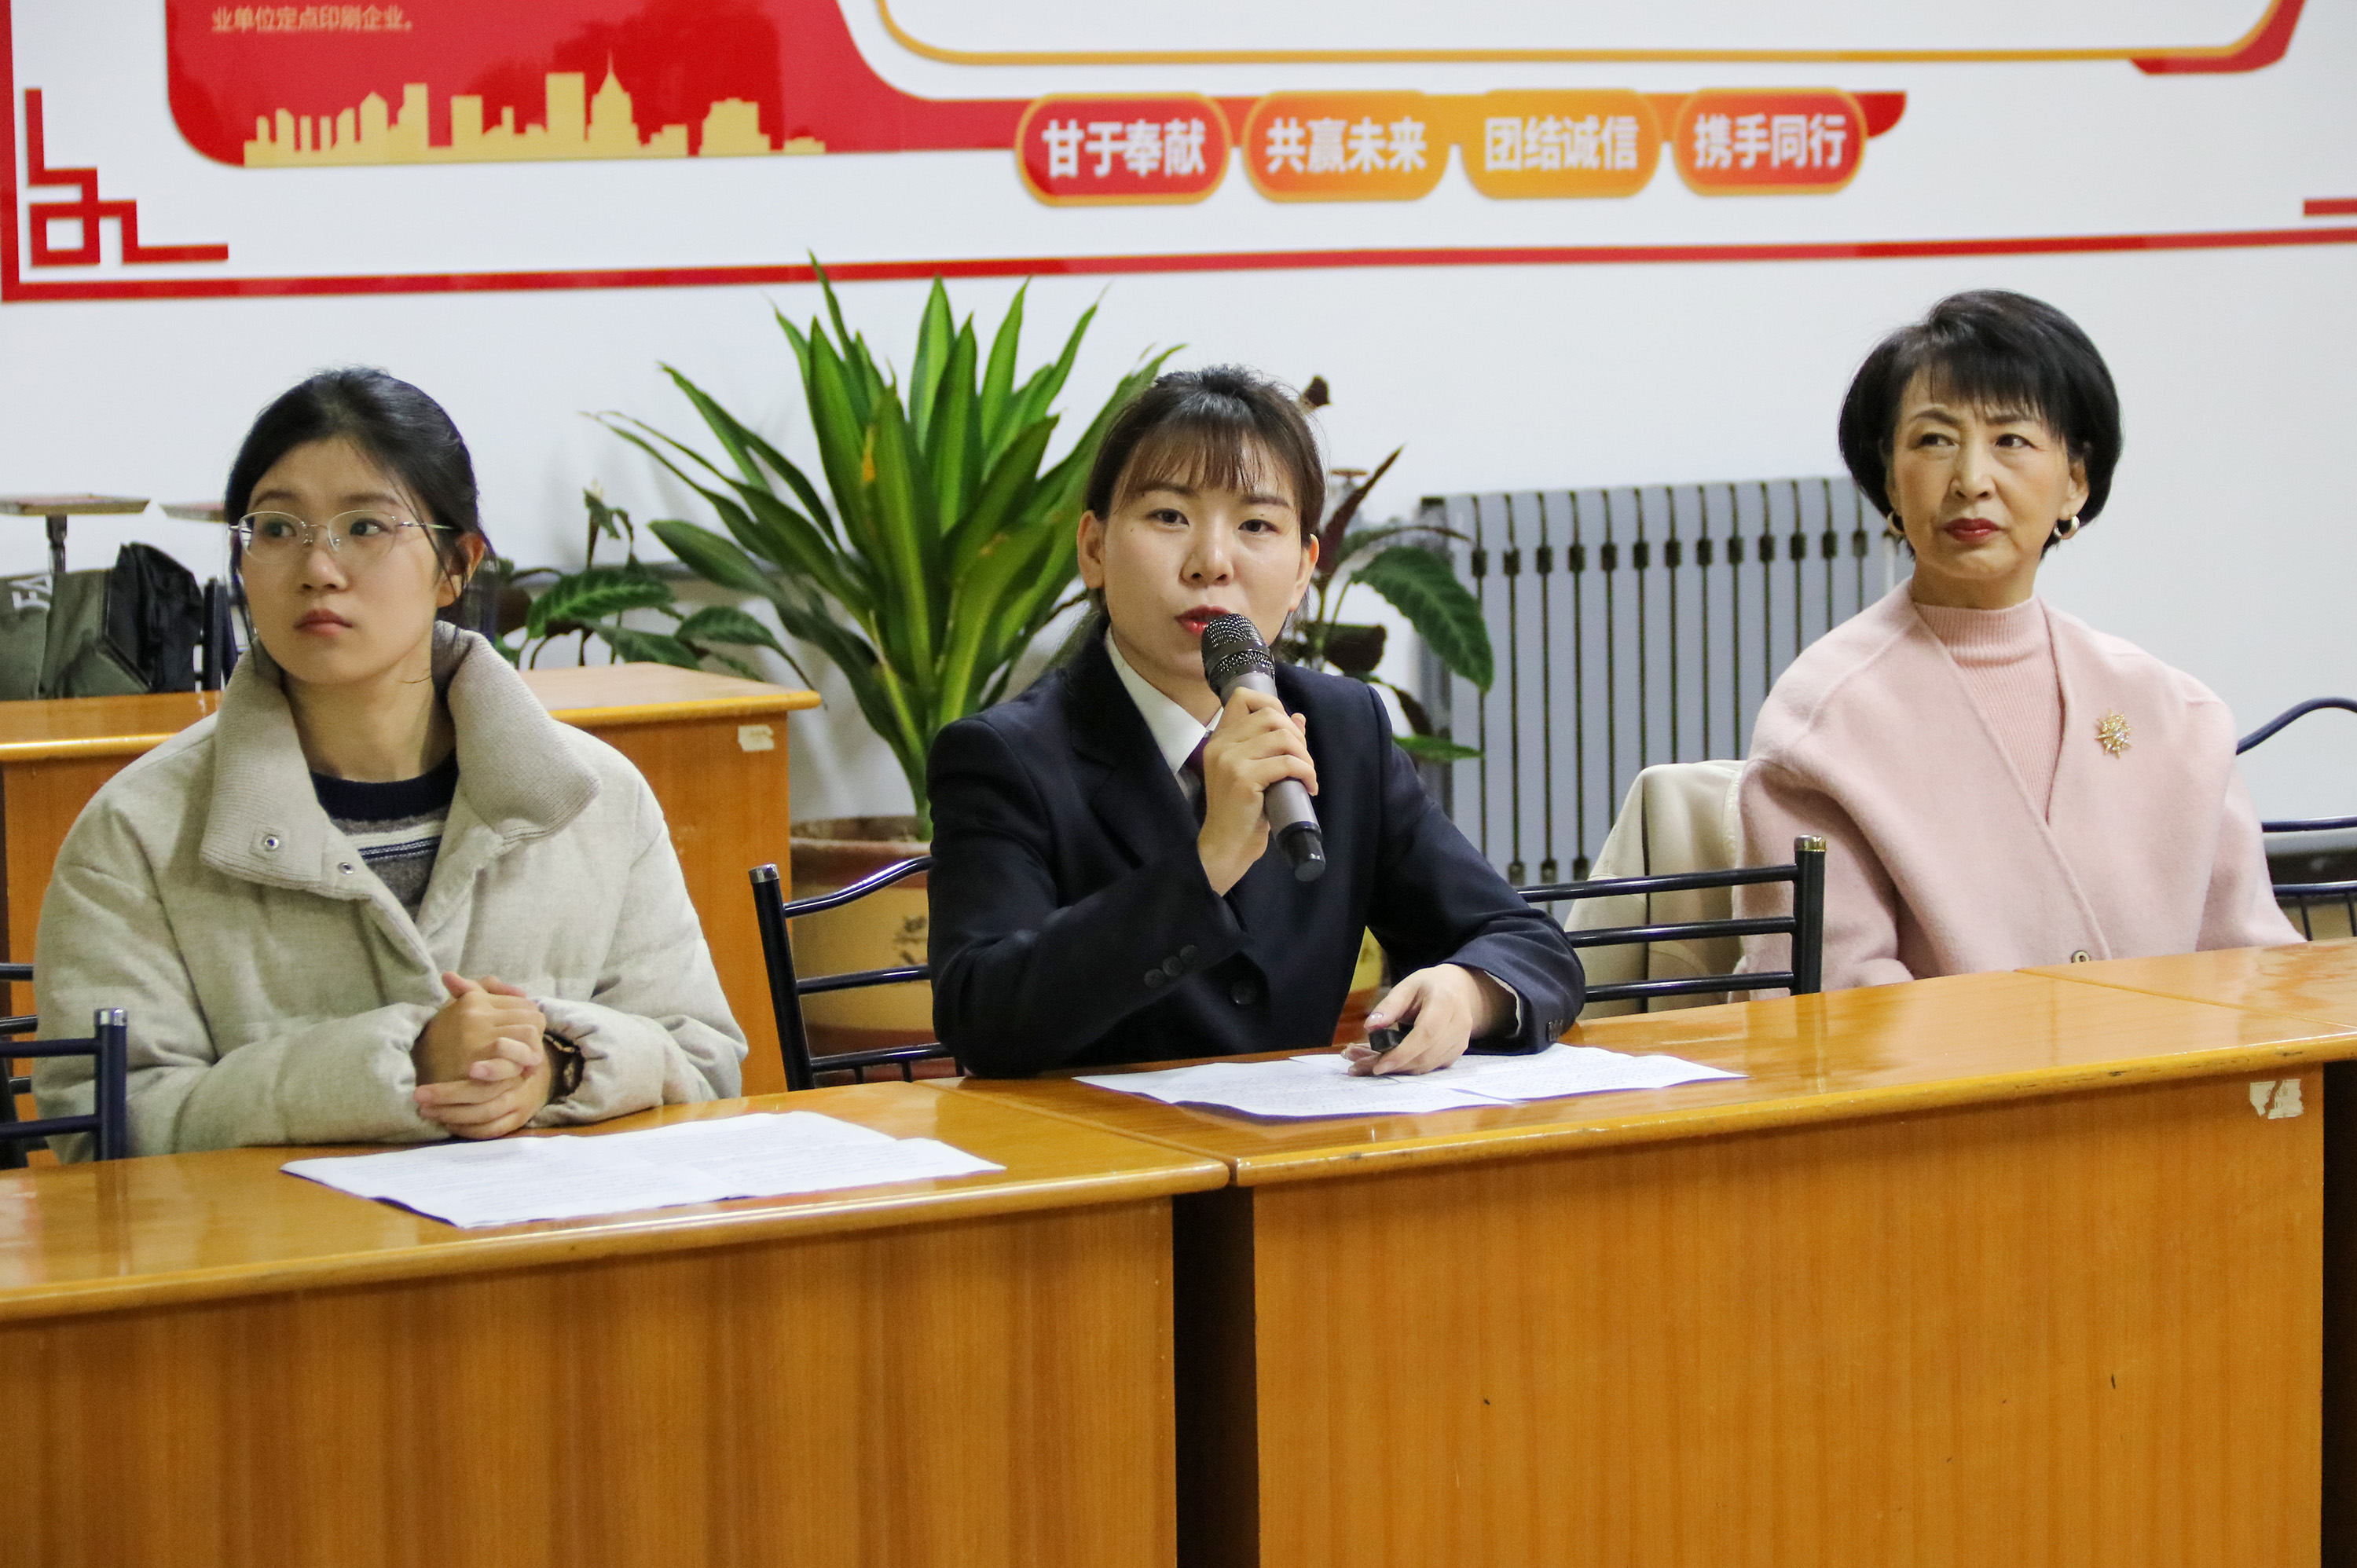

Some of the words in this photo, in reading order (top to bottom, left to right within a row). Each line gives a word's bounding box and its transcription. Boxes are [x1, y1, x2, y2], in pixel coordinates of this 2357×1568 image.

[1042, 118, 1207, 179] 甘于奉献
[1266, 116, 1428, 174] 共赢未来
[1484, 114, 1640, 172] 团结诚信
[1693, 112, 1847, 170] 携手同行
